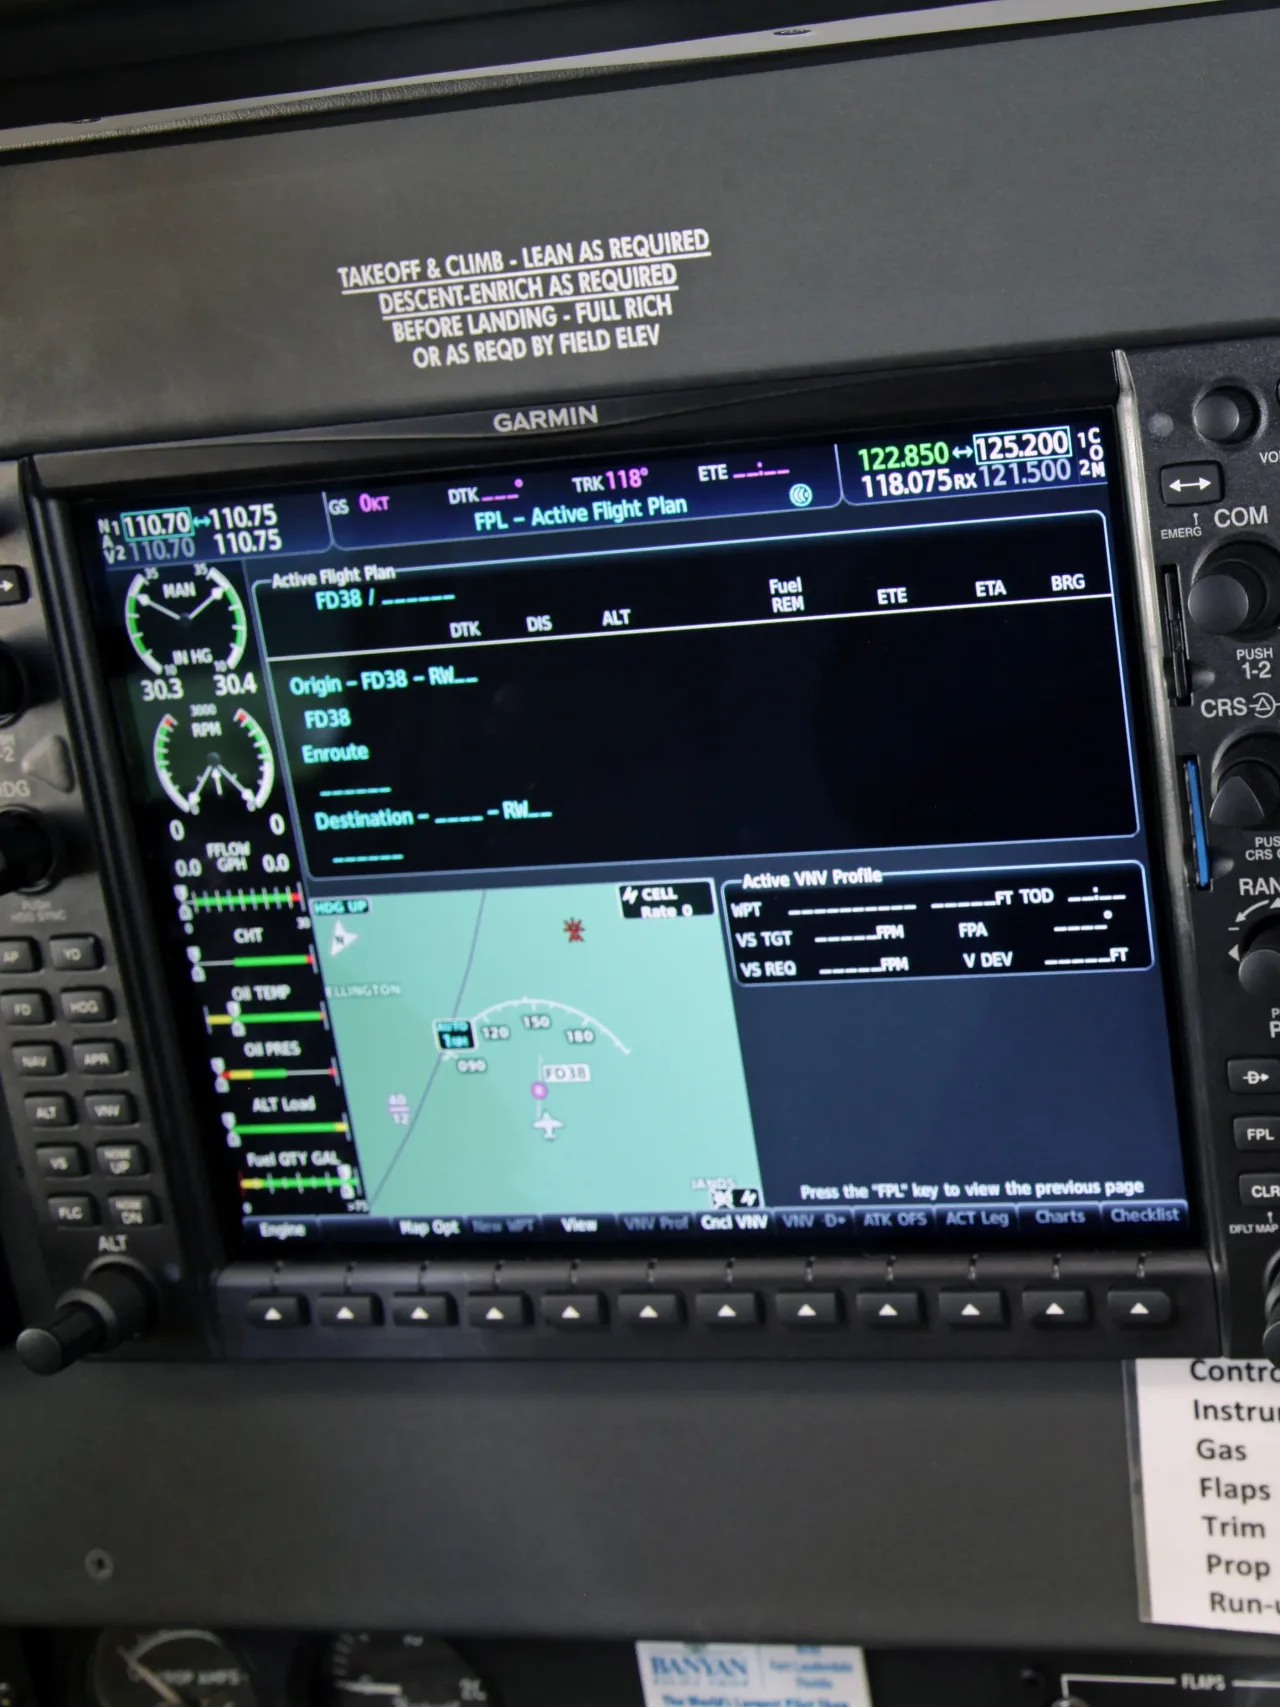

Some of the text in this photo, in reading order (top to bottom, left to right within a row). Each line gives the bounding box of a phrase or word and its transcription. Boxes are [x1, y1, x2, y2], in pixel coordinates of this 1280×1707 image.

[338, 228, 709, 289] TAKEOFF & CLIMB LEAN AS REQUIRED
[378, 263, 678, 315] DESCENT-ENRICH AS REQUIRED
[392, 294, 673, 342] BEFORE LANDING FULL RICH
[412, 323, 660, 369] OR AS REQD BY FIELD ELEV
[494, 404, 599, 433] GARMIN
[858, 430, 1069, 471] 122.850 125.200
[698, 464, 728, 481] ETE
[862, 458, 1071, 498] 118.075 121.500
[572, 476, 604, 493] TRK
[448, 488, 479, 505] DTK
[329, 500, 349, 515] GS
[474, 496, 687, 531] FPL Active Flight Plan
[124, 504, 277, 537] 110.70 110.75
[1214, 506, 1269, 528] COM
[1161, 527, 1202, 539] EMERG
[131, 529, 282, 561] 110.70 110.75
[271, 566, 396, 589] Active Flight Plan
[769, 577, 802, 594] Fuel
[1051, 574, 1085, 591] BRG
[877, 587, 908, 604] ETE
[975, 580, 1007, 597] ETA
[316, 591, 362, 609] FD38
[772, 596, 804, 613] REM
[527, 616, 552, 632] DIS
[603, 609, 630, 626] ALT
[450, 621, 481, 638] DTK
[1237, 648, 1273, 661] PUSH
[1242, 661, 1272, 679] 1-2
[141, 678, 183, 700] 30.3
[213, 673, 257, 695] 30.4
[290, 669, 408, 697] Origin FD38
[1201, 698, 1247, 718] CRS
[304, 708, 351, 728] FD38
[191, 721, 222, 737] RPM
[302, 743, 369, 763] Enroute
[315, 808, 414, 830] Destination
[1245, 849, 1273, 861] CRS
[742, 867, 883, 890] Active VNV Profile
[1019, 888, 1054, 904] TOD
[730, 901, 761, 919] WPT
[736, 931, 792, 948] VS TGT
[959, 923, 988, 938] FPA
[740, 961, 796, 978] VS REQ
[963, 952, 1013, 969] V DEV
[1247, 1128, 1275, 1140] FPL
[800, 1180, 1144, 1200] Press the "FPL" key to view the previous page
[1251, 1185, 1280, 1198] CLR
[1035, 1208, 1085, 1224] Charts
[1111, 1206, 1180, 1224] Checklist
[99, 1235, 127, 1251] ALT
[1197, 1439, 1247, 1460] Gas
[1200, 1477, 1271, 1504] Flaps
[1202, 1516, 1266, 1538] Trim
[1206, 1554, 1270, 1581] Prop
